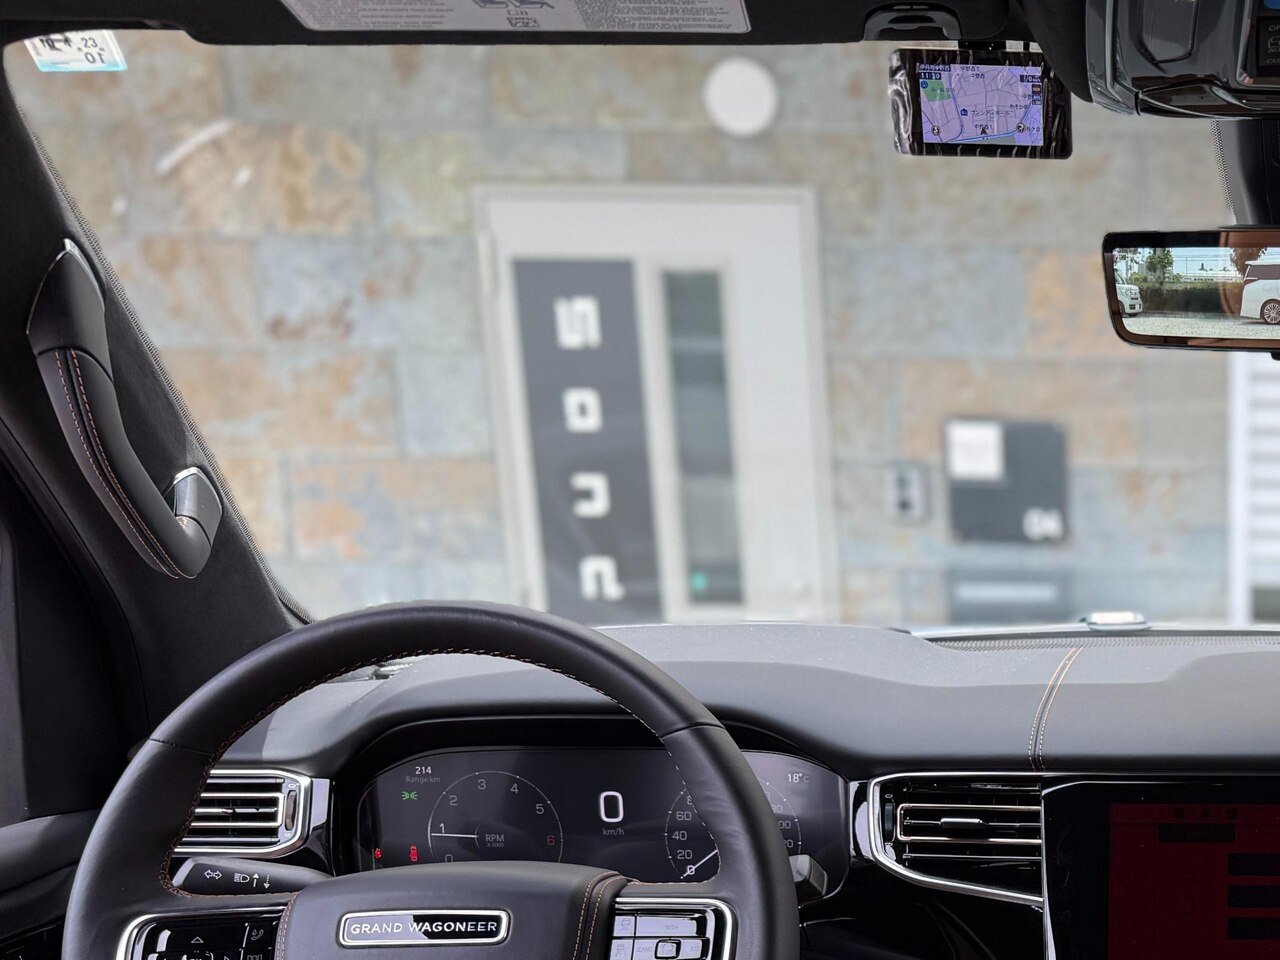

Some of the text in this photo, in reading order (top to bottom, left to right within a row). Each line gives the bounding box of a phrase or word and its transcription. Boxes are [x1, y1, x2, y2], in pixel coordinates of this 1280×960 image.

[415, 766, 432, 775] 214
[477, 779, 486, 790] 3
[510, 783, 519, 793] 4
[450, 795, 458, 806] 2
[536, 804, 545, 814] 5
[600, 791, 624, 823] 0
[676, 811, 692, 821] 60
[440, 823, 446, 834] 1
[602, 828, 625, 837] km/h
[485, 834, 505, 843] RPM
[547, 835, 555, 846] 6
[672, 831, 688, 841] 40
[677, 850, 693, 860] 20
[351, 921, 497, 934] GRAND WAGONEER
